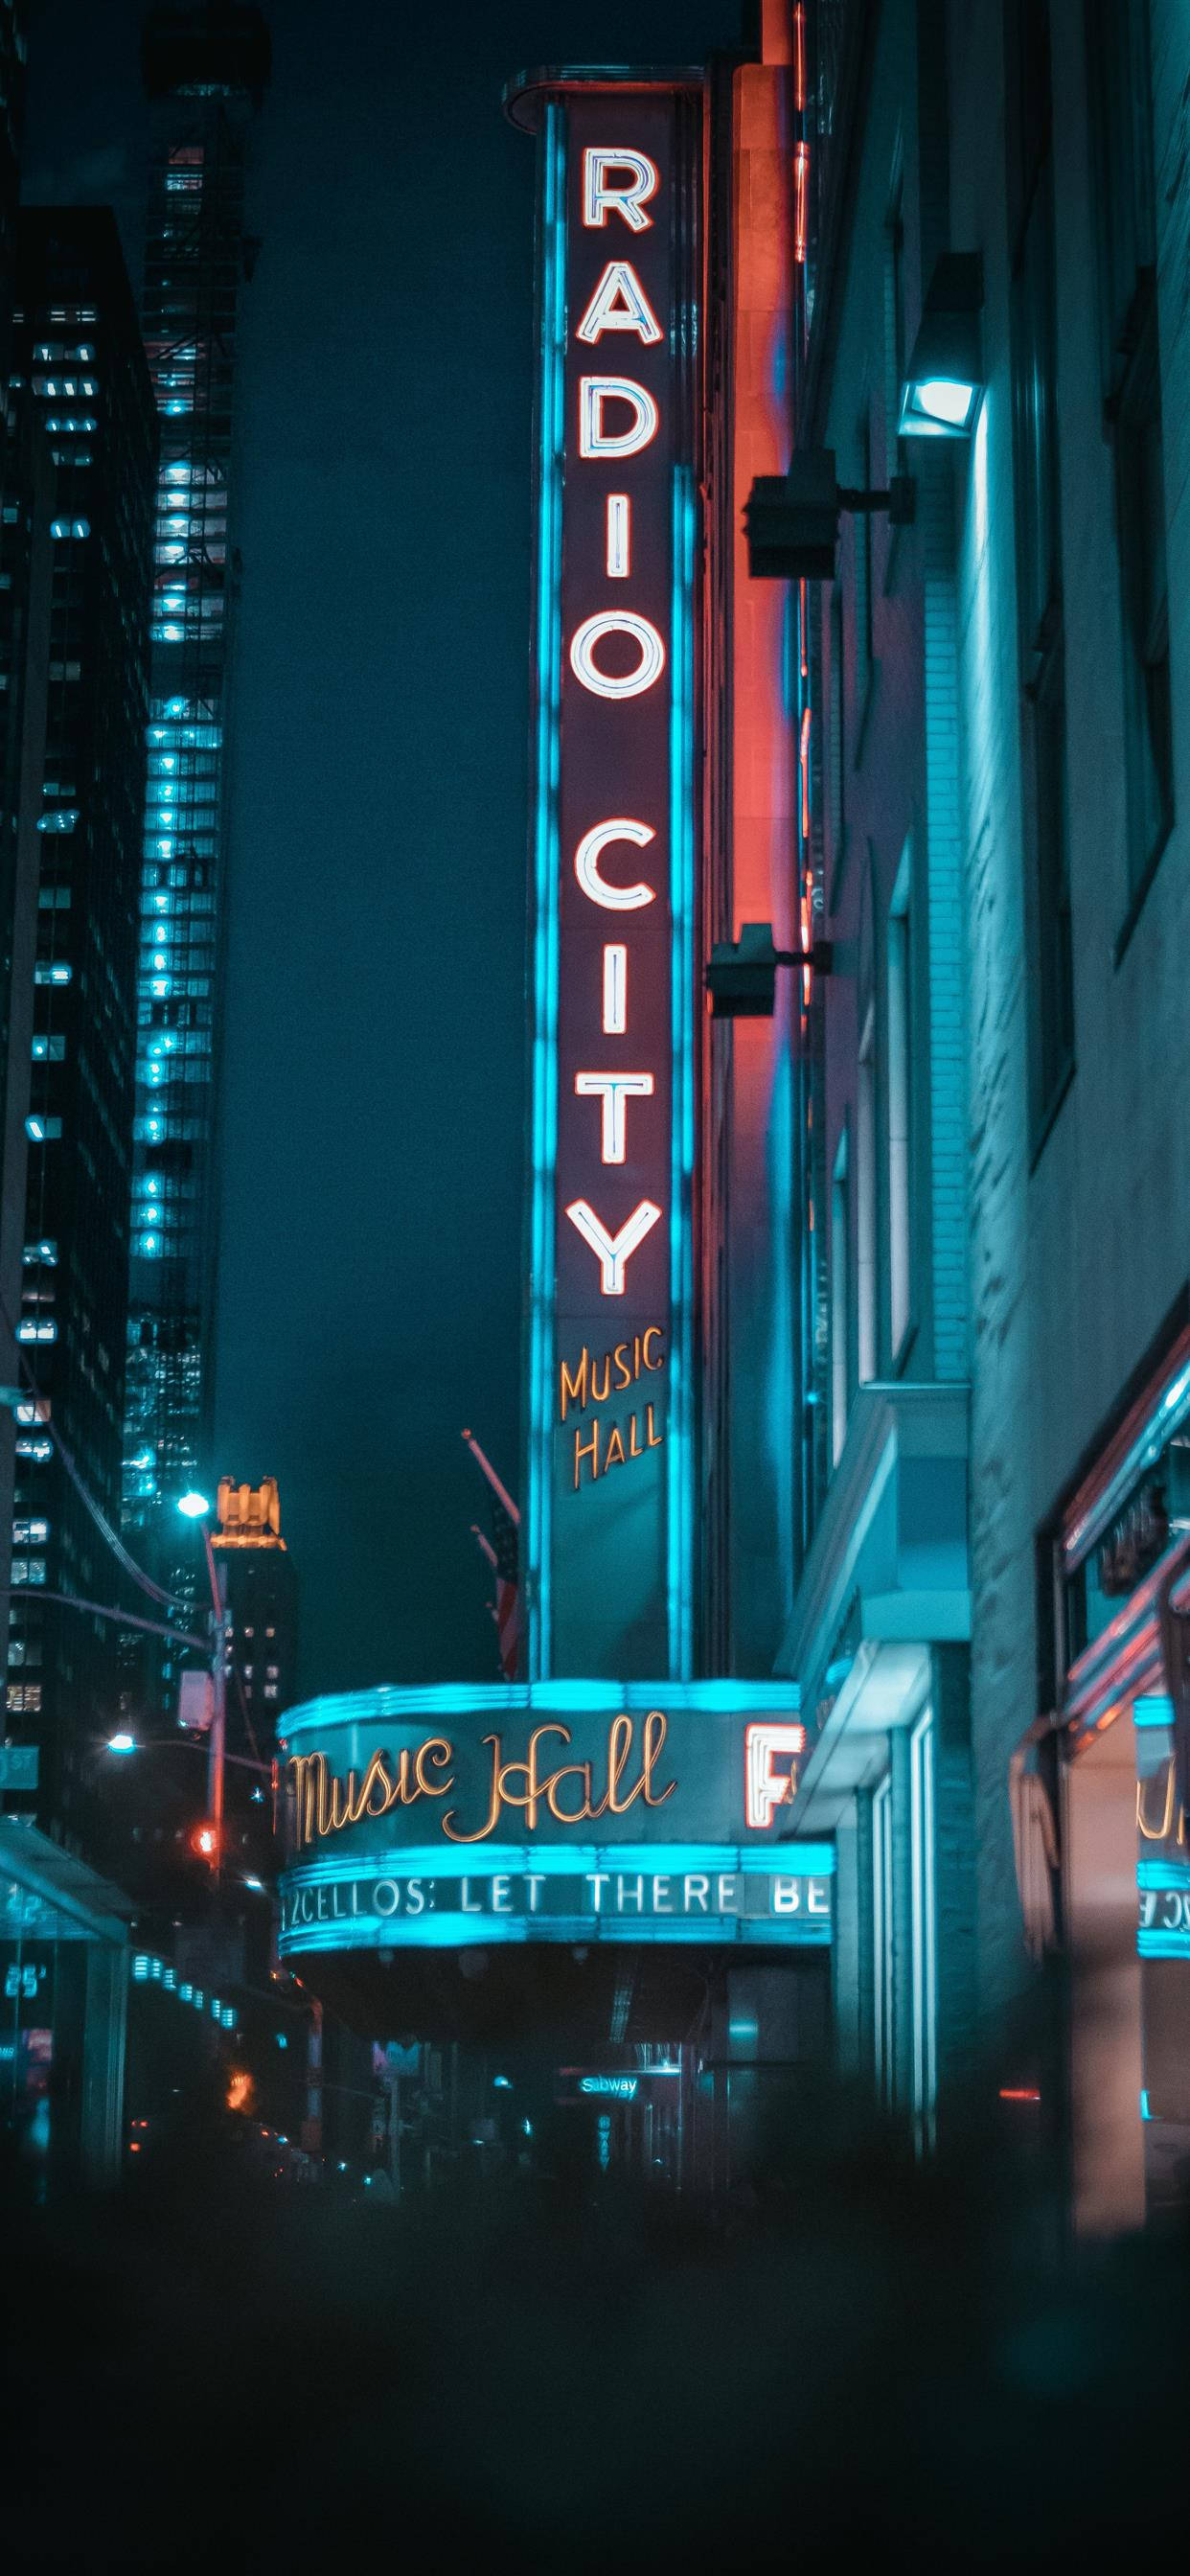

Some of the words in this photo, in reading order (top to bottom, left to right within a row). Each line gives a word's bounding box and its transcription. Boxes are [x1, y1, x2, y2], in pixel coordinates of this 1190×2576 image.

[569, 146, 666, 701] RADIO
[565, 817, 662, 1295] CITY
[560, 1325, 663, 1422] MUSIC
[575, 1402, 663, 1490] HALL
[289, 1736, 455, 1852] Music
[442, 1711, 677, 1842] Hall
[461, 1874, 547, 1913] LET
[585, 1874, 739, 1914] THERE
[773, 1875, 830, 1914] BE
